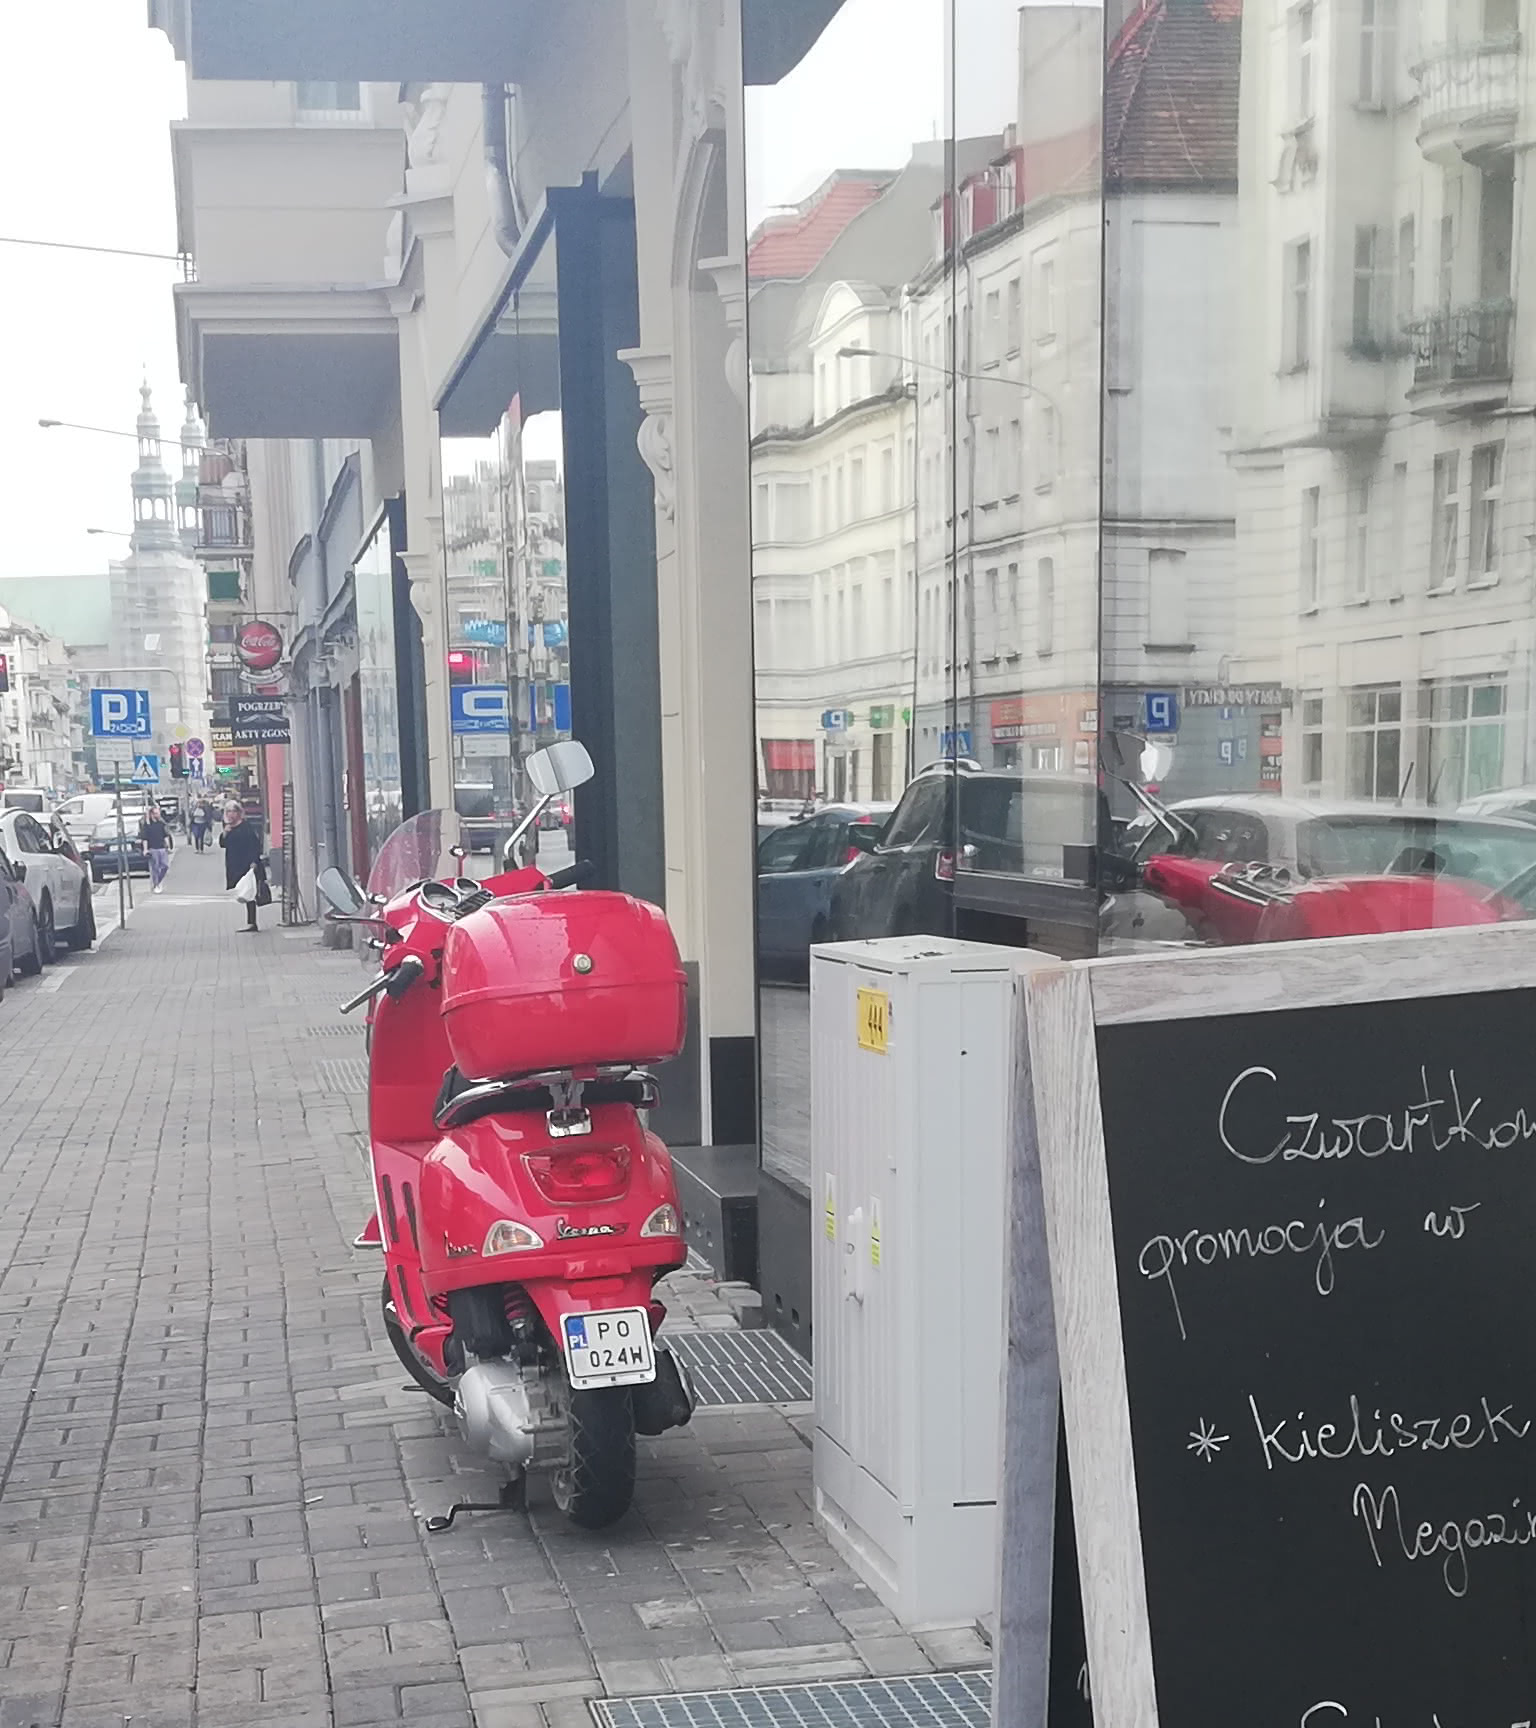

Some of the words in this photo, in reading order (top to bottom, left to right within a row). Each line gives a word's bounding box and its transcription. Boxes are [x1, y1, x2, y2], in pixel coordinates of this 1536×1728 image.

[101, 693, 128, 731] P
[235, 729, 260, 739] AKTY
[556, 1217, 615, 1240] Vespa
[1138, 1199, 1386, 1341] promocja
[1424, 1201, 1482, 1239] w
[569, 1335, 588, 1350] PL
[589, 1345, 644, 1368] 024W
